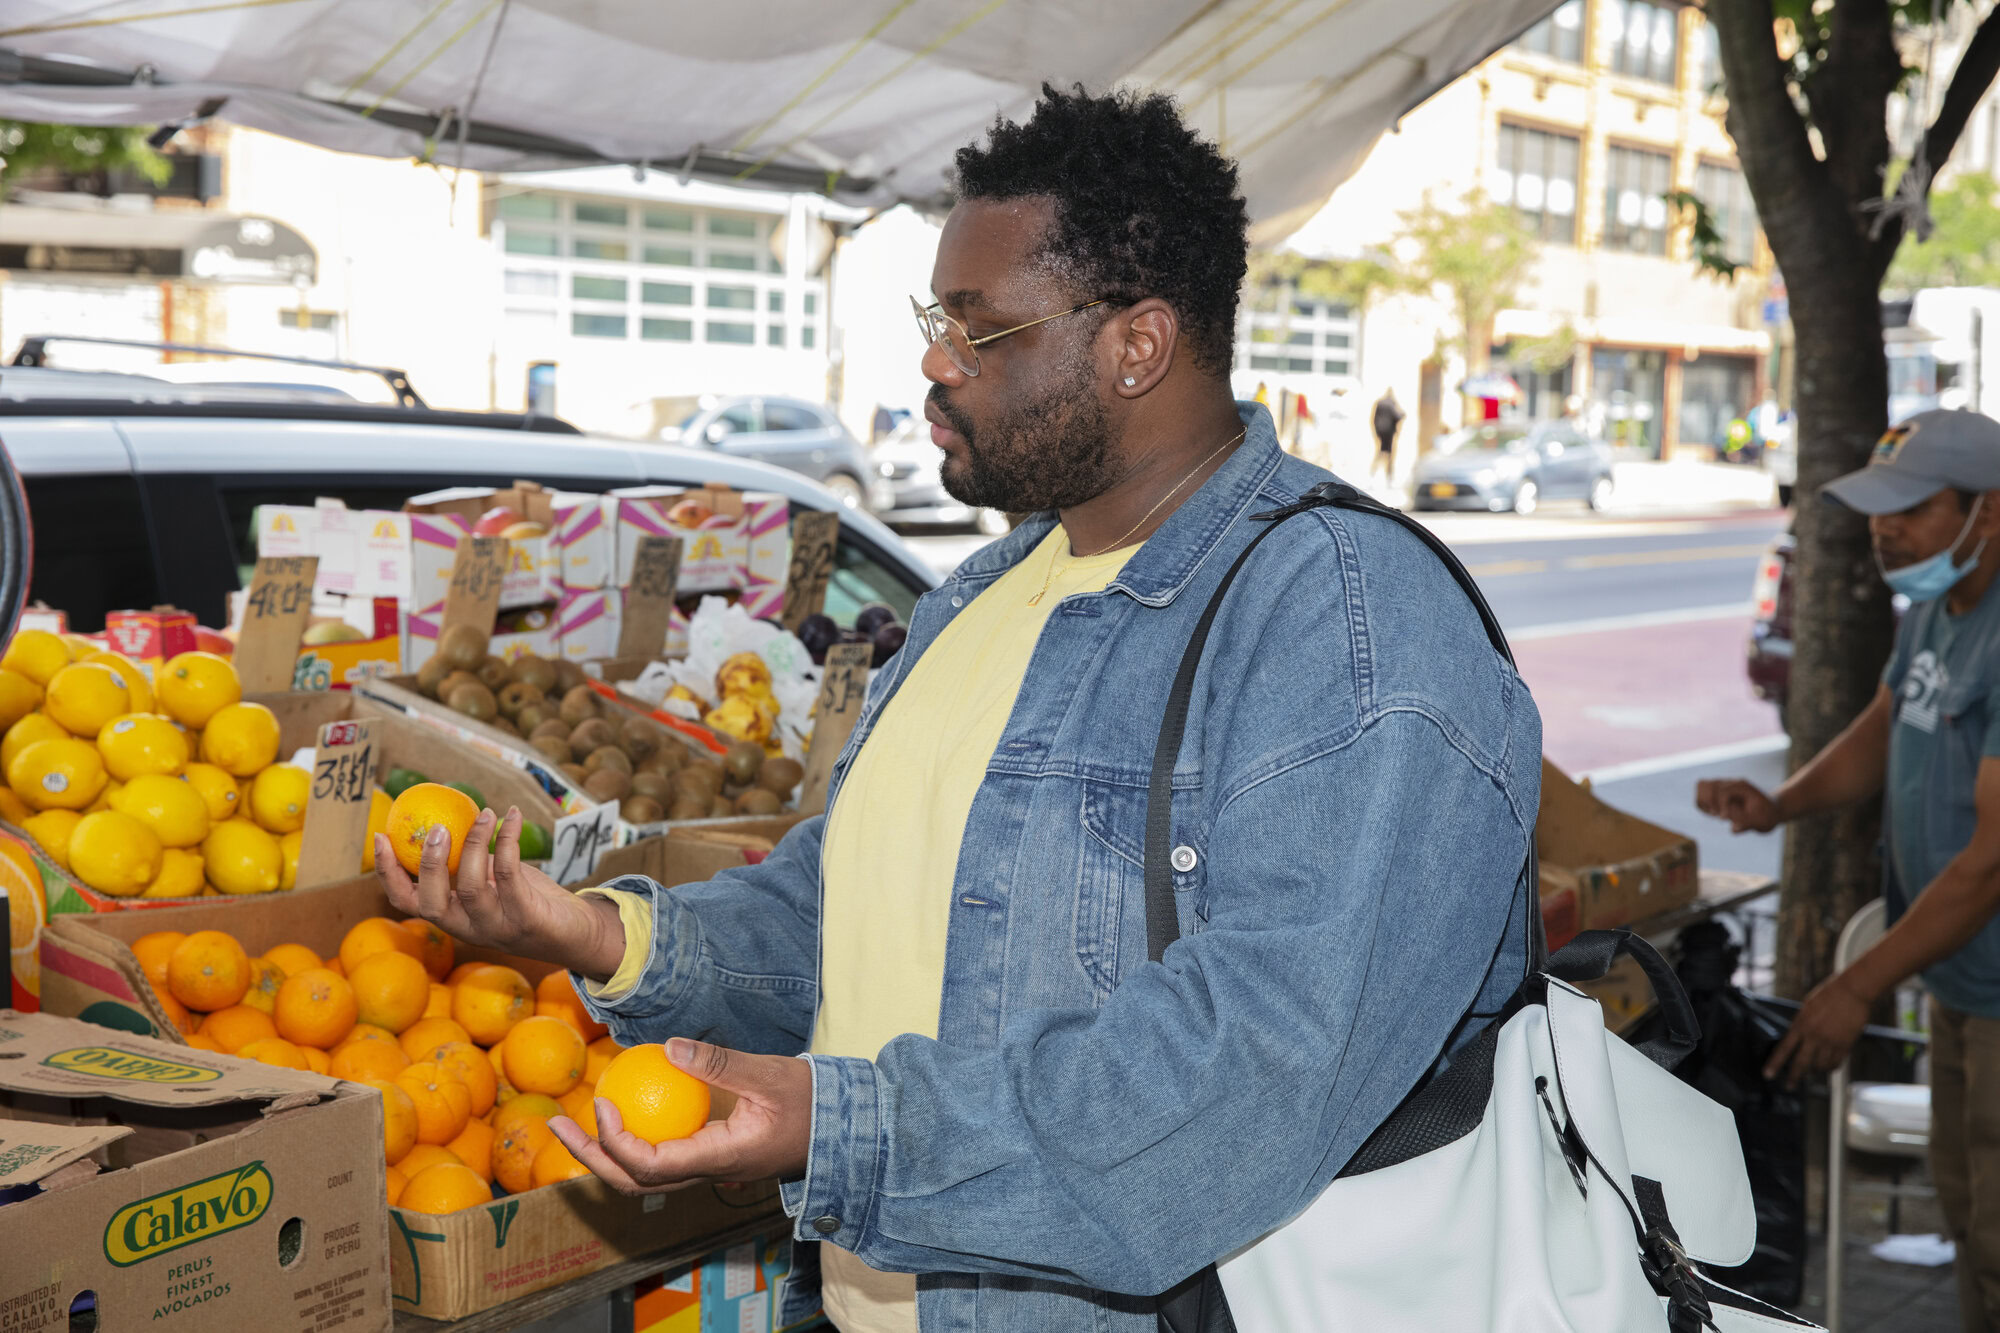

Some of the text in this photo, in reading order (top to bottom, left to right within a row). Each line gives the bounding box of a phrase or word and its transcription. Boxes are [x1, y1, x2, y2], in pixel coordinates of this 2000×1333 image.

[314, 758, 338, 799] 3
[72, 1050, 200, 1080] Calavo
[327, 1171, 353, 1189] COUNT
[123, 1175, 258, 1253] Calavo
[324, 1222, 360, 1244] PRODUCE
[325, 1238, 360, 1260] OF PERU
[167, 1255, 212, 1281] PERU'S
[0, 1281, 62, 1314] ISTRIBUTED BY
[167, 1272, 214, 1299] FINEST
[152, 1282, 231, 1321] AVOCADOS
